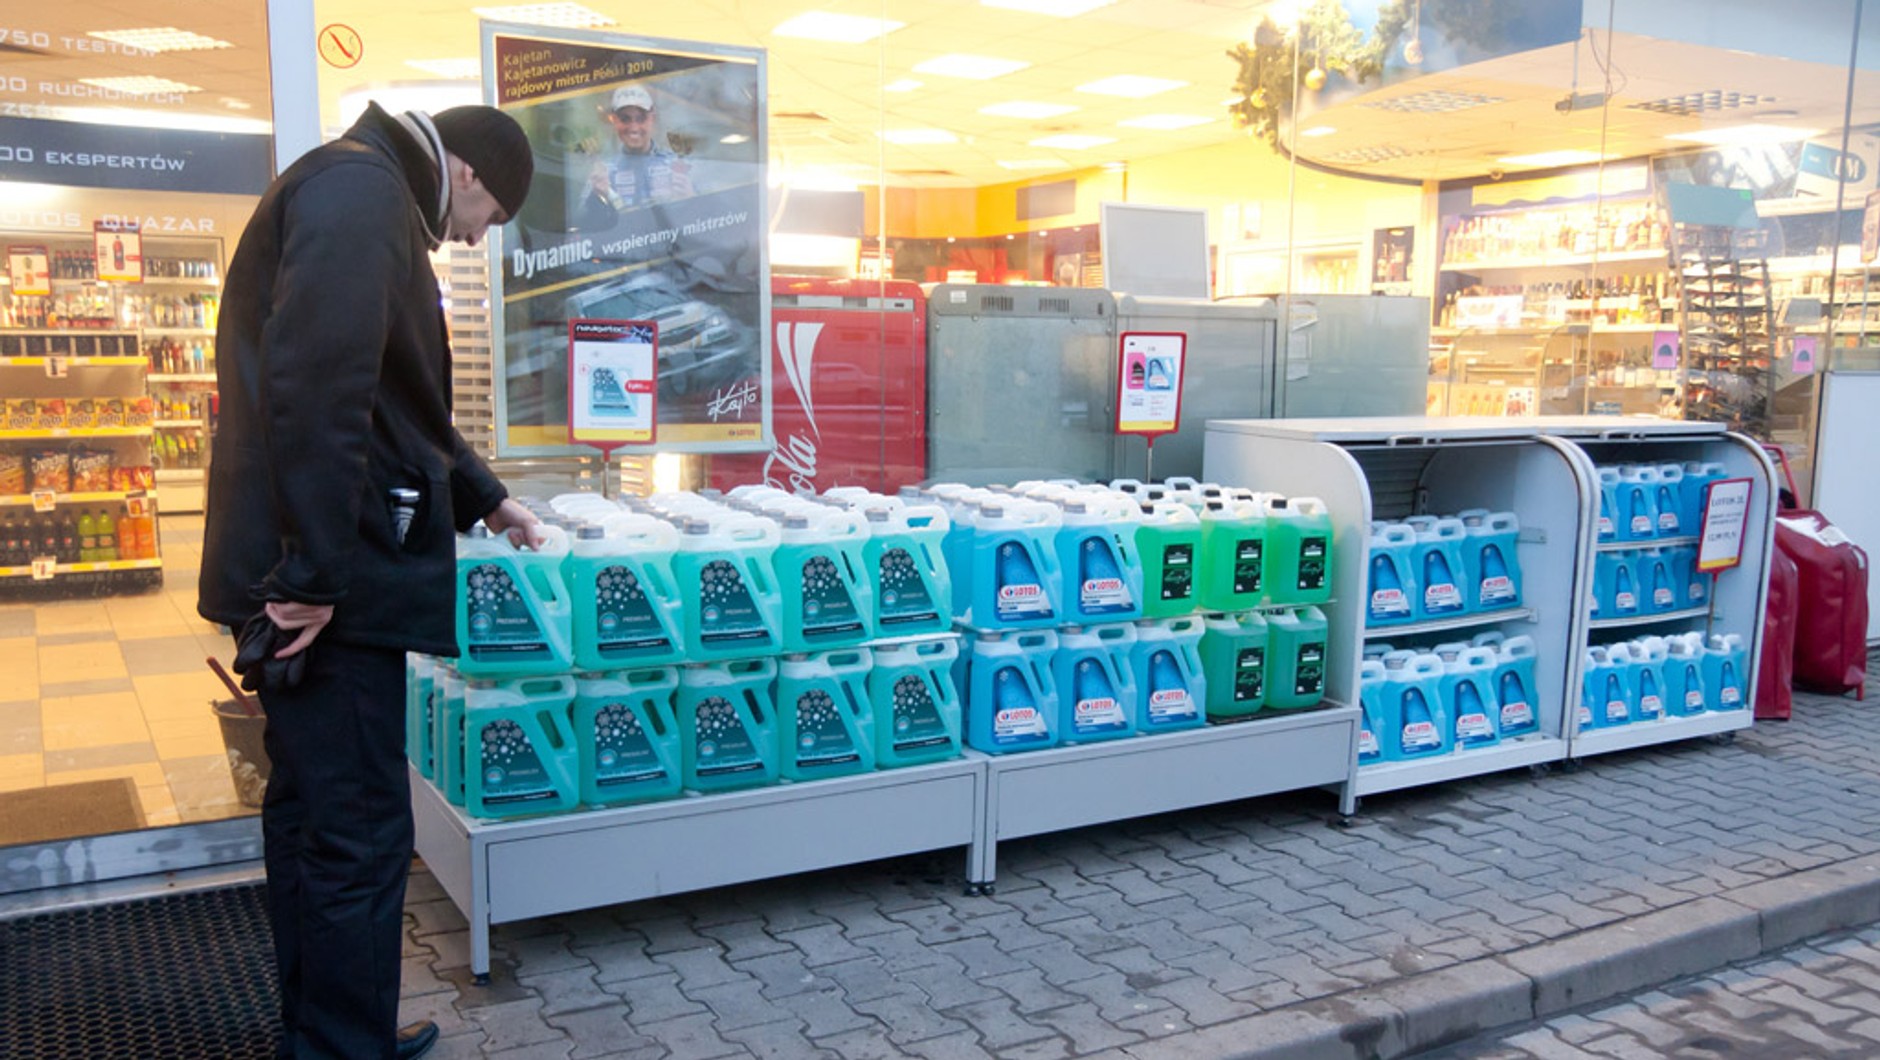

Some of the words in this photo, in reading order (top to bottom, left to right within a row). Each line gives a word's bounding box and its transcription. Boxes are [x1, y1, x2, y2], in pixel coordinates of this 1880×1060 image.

[503, 50, 552, 68] Kajetan
[504, 57, 587, 82] Kajetanowicz
[505, 81, 554, 98] rajdowy
[556, 73, 590, 88] mistrz
[627, 60, 653, 75] 2010
[46, 151, 186, 171] EKSPERTÓW
[1, 210, 81, 227] OTOS
[101, 213, 215, 232] QUAZAR
[513, 239, 593, 279] Dynamic
[601, 228, 680, 255] wspieramy
[682, 210, 748, 235] mistrzów
[1096, 580, 1119, 590] LOTOS
